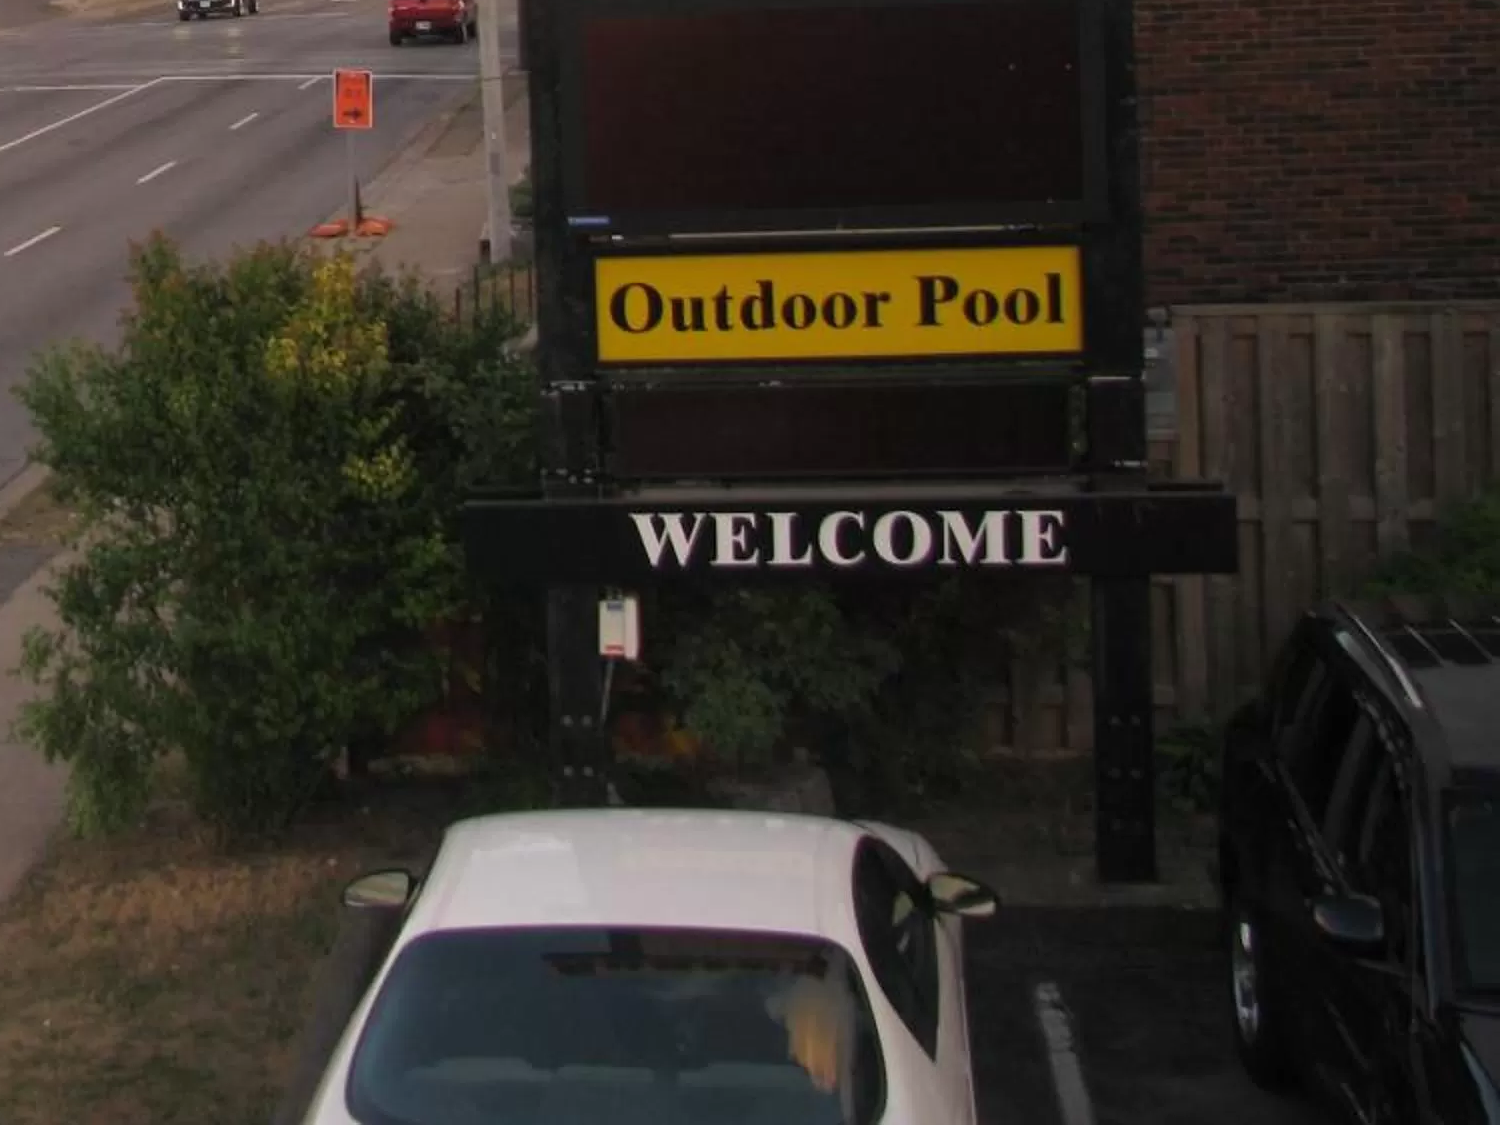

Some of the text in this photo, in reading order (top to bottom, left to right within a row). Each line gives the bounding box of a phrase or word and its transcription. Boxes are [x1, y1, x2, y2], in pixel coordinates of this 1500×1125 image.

[608, 271, 1067, 334] Outdoor Pool
[628, 508, 1070, 571] WELCOME
